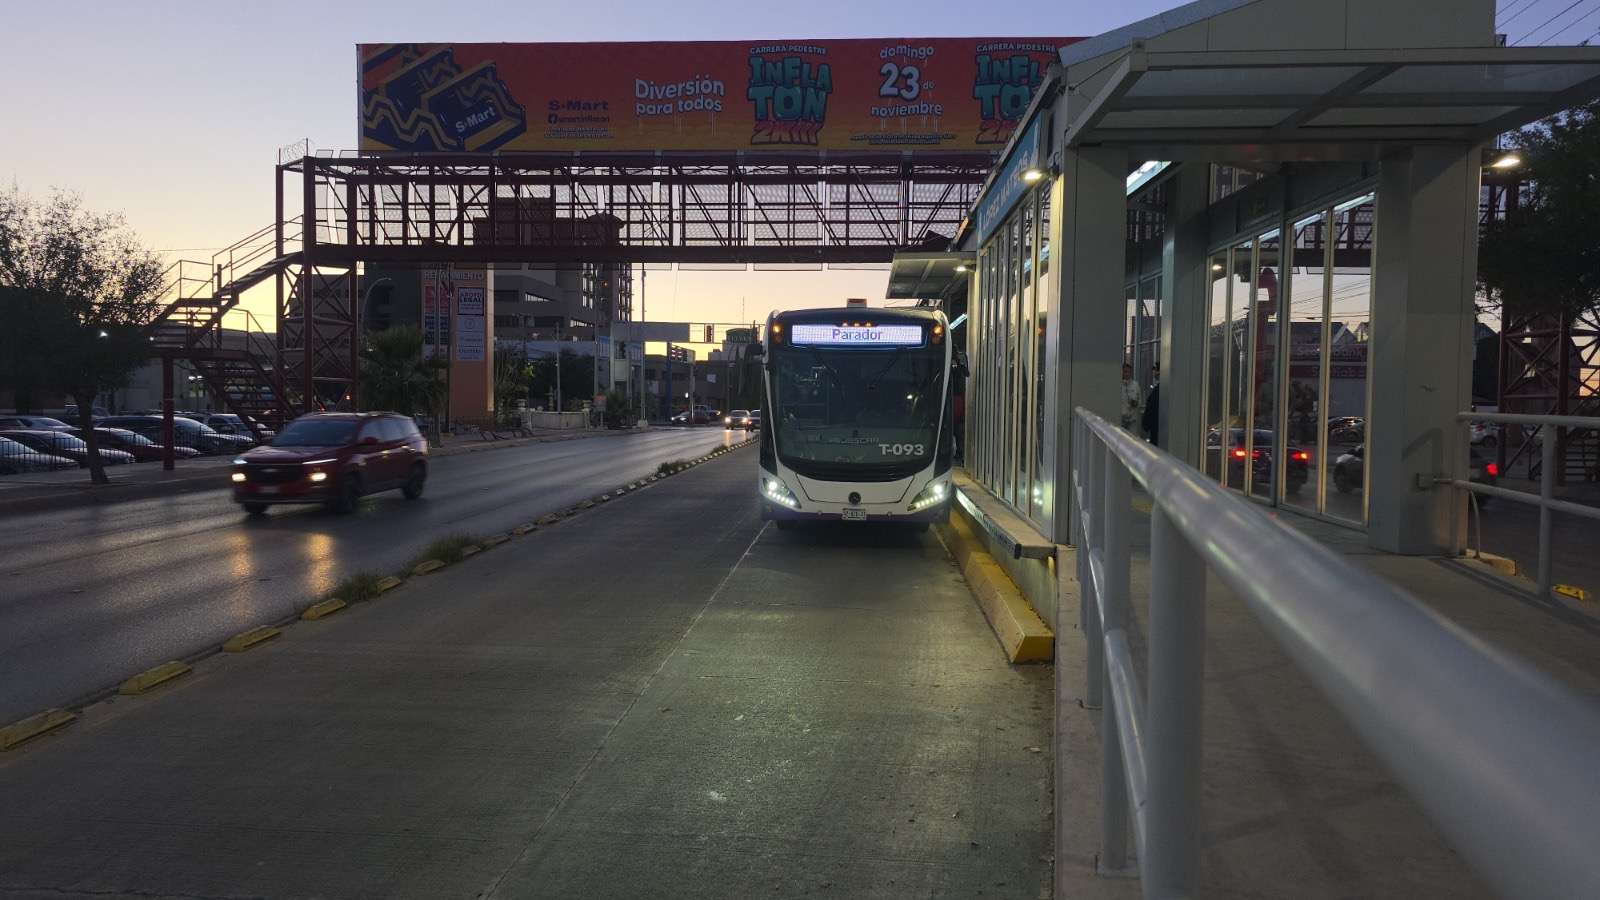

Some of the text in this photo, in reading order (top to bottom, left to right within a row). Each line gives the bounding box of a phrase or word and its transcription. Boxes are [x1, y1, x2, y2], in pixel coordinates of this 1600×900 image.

[750, 45, 826, 55] CARRERA PEDESTRE
[880, 45, 934, 59] domingo
[976, 43, 1056, 53] CARRERA PEDESTRE
[748, 55, 832, 93] INFLA
[976, 54, 1044, 84] INFL
[635, 74, 724, 99] Diversión
[880, 62, 920, 100] 23
[636, 95, 722, 117] para todos
[747, 84, 828, 122] TON
[871, 100, 943, 117] noviembre
[972, 81, 1031, 120] TO
[832, 329, 882, 341] Parador
[879, 443, 924, 456] T-093
